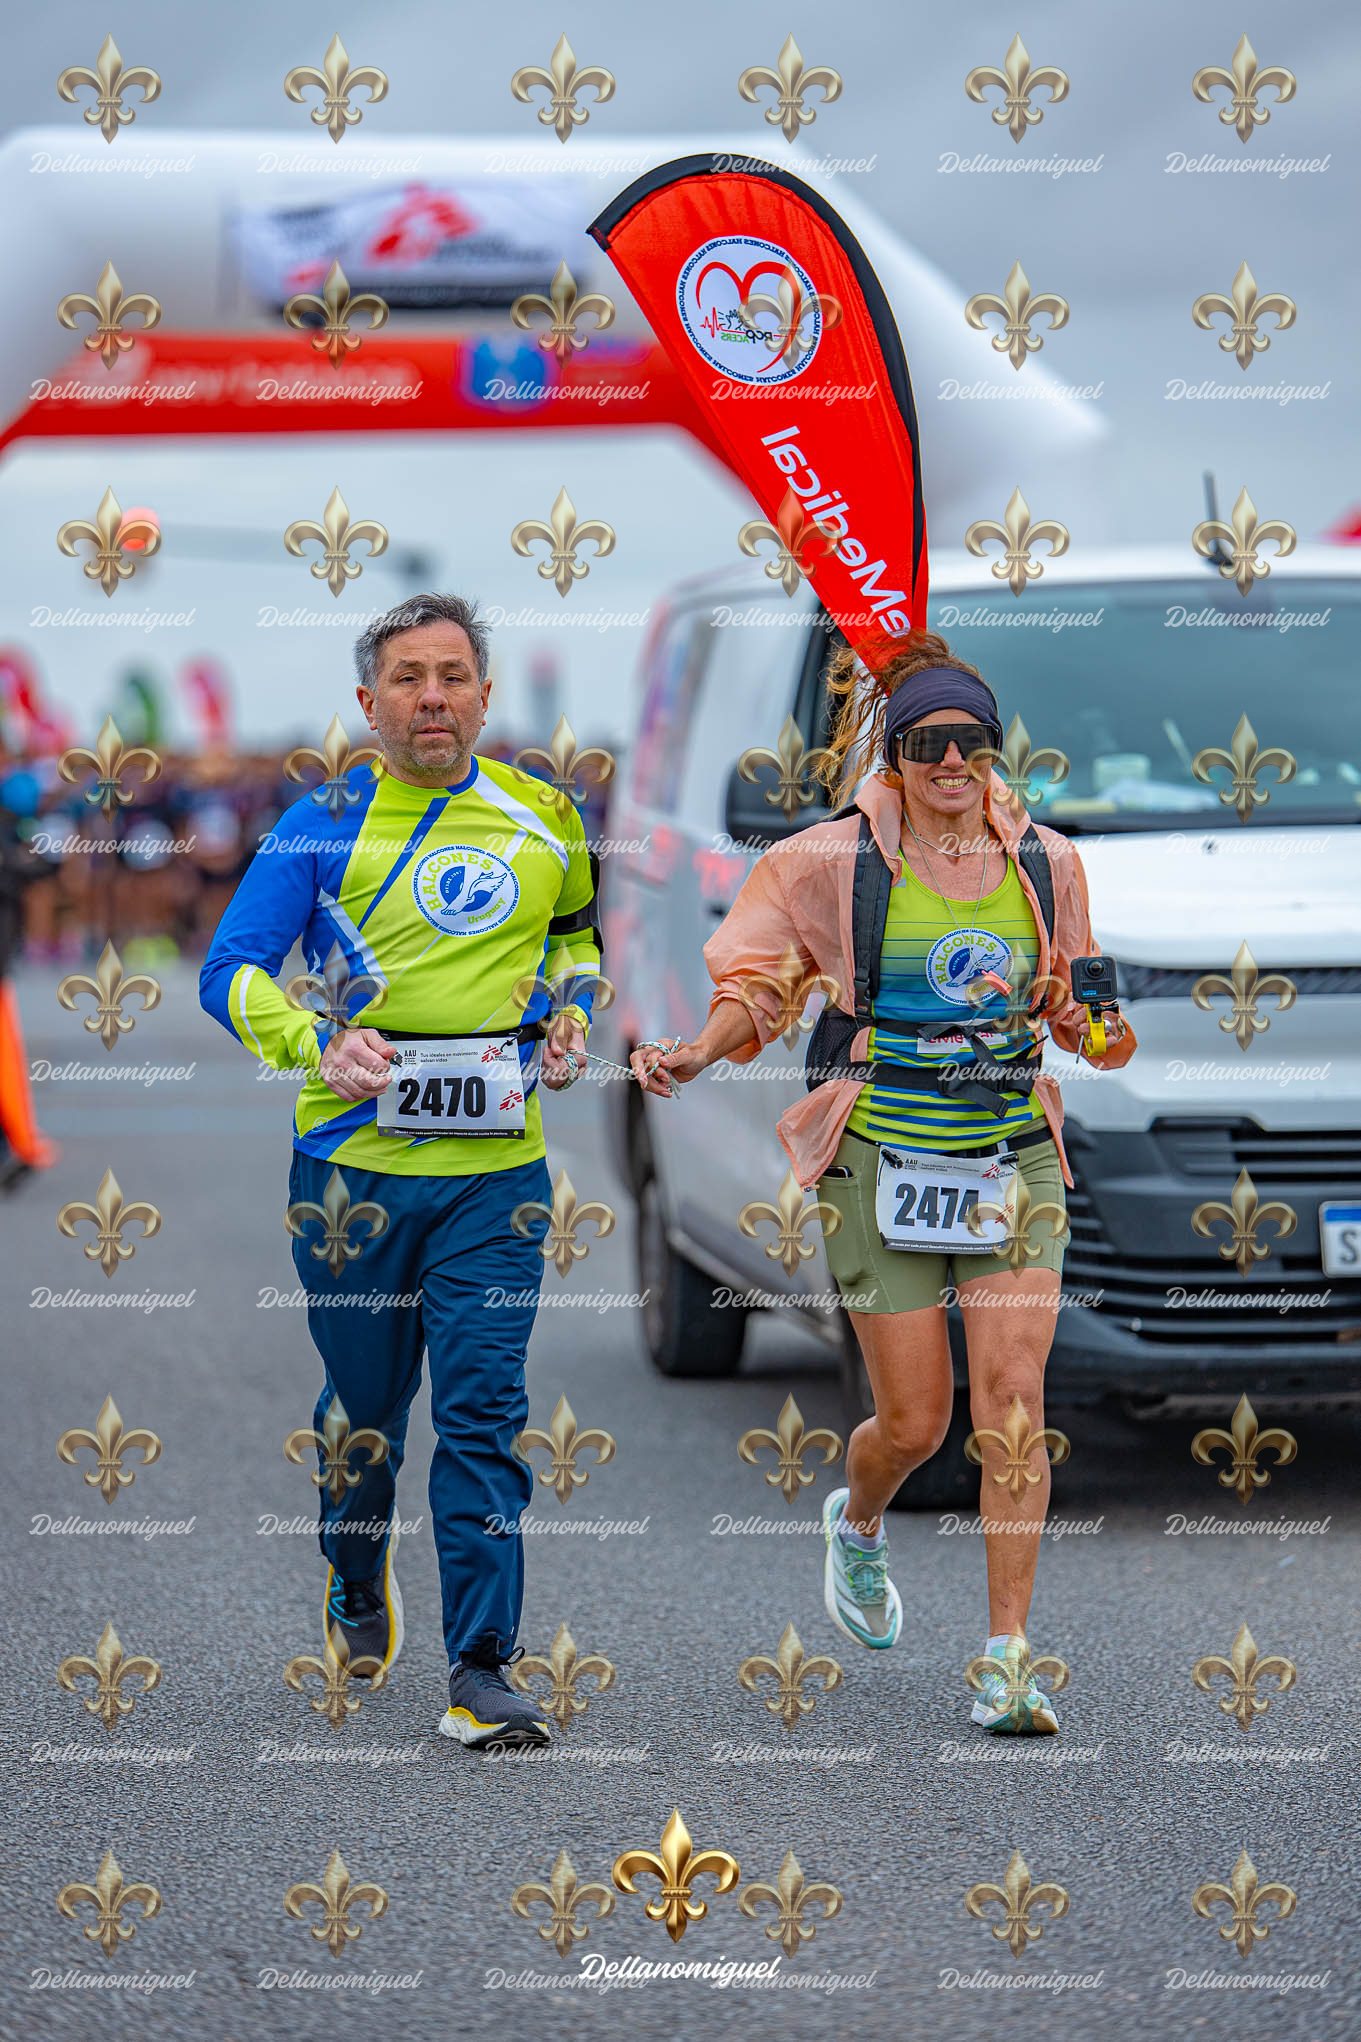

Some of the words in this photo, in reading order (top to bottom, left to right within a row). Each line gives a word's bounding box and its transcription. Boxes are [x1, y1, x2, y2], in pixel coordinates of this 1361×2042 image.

[423, 852, 494, 912] HALCONES
[467, 897, 507, 924] Uruguay
[935, 935, 998, 984] HALCONES
[398, 1076, 486, 1118] 2470
[894, 1182, 981, 1231] 2474
